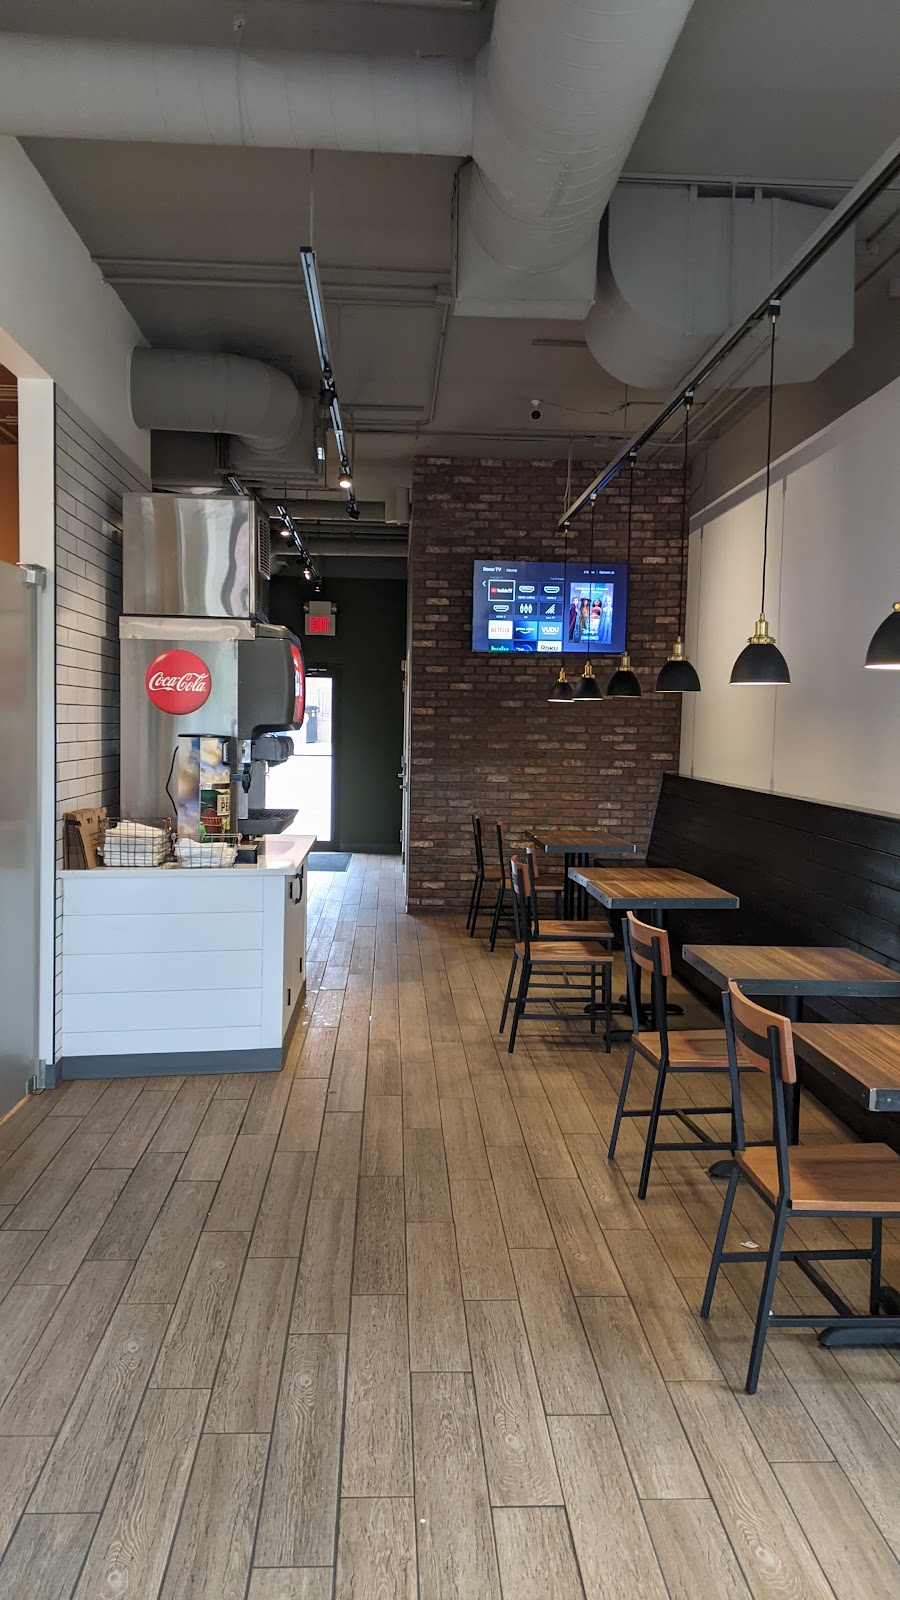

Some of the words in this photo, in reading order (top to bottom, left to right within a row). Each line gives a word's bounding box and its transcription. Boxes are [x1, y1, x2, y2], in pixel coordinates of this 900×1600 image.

[310, 617, 329, 633] EXIT
[149, 671, 209, 692] Coca-Cola
[221, 802, 230, 812] PE
